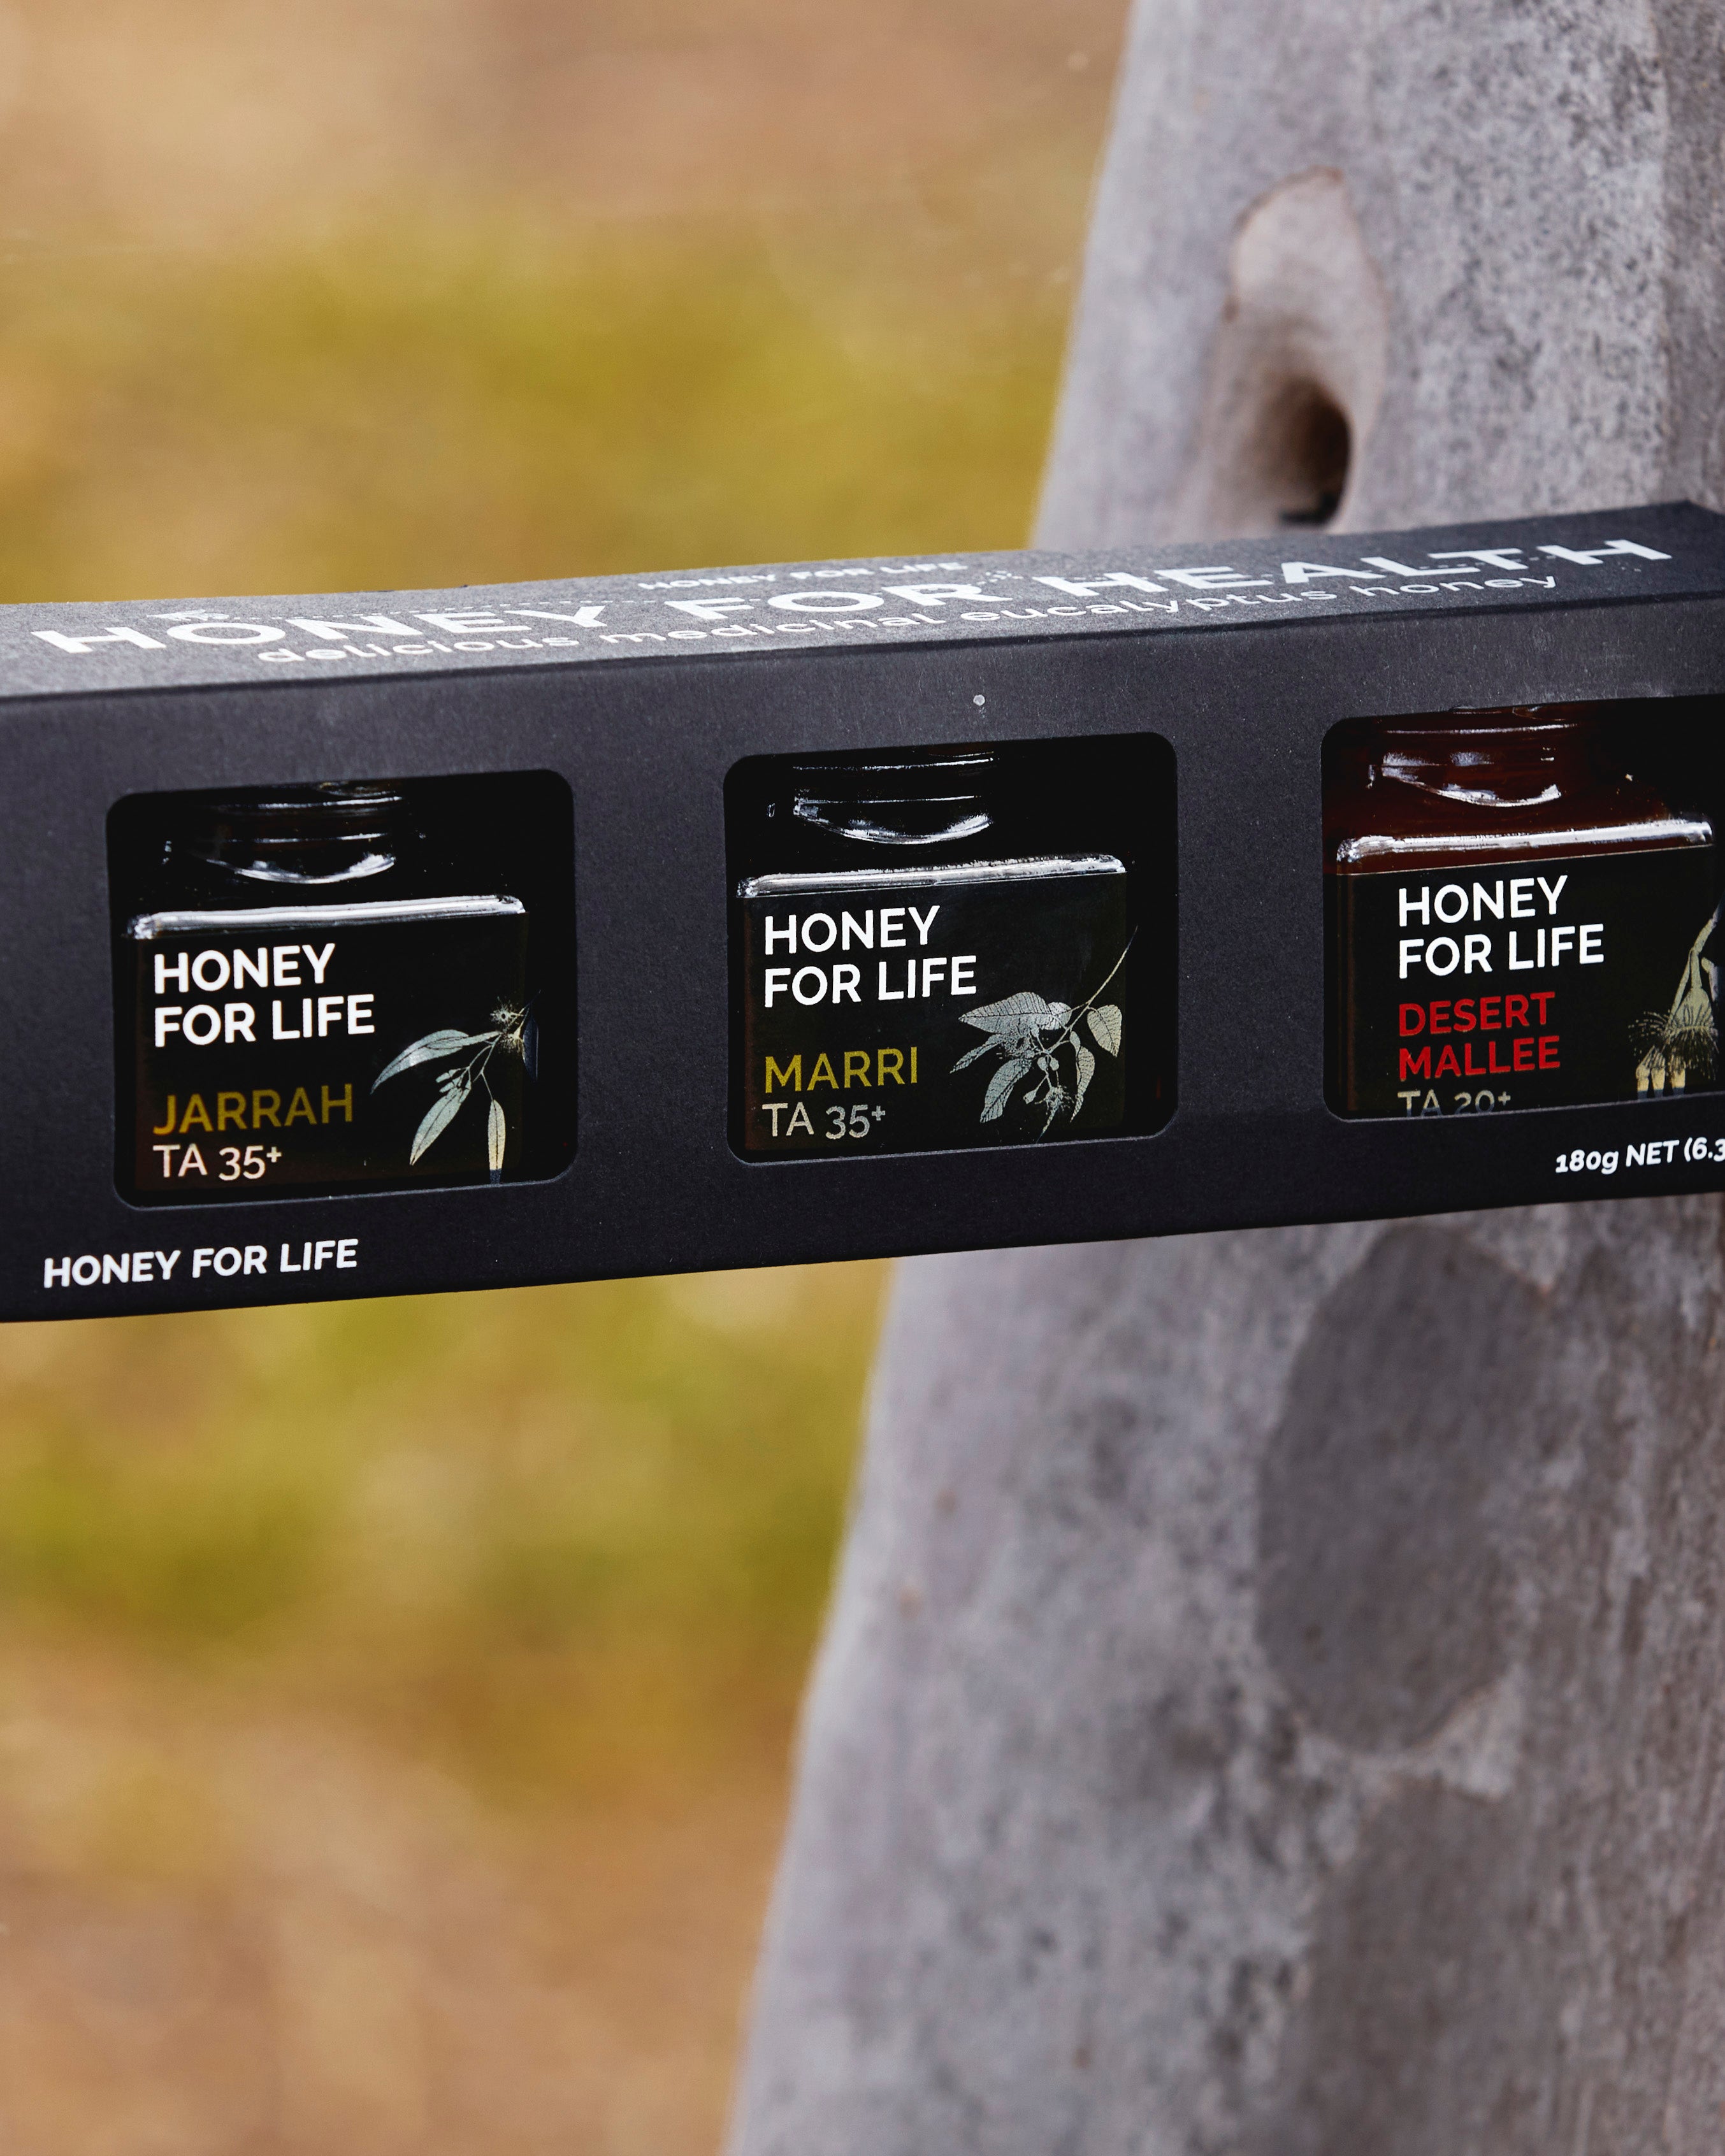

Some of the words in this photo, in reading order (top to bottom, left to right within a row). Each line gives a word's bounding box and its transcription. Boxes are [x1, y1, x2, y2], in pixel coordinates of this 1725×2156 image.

[31, 605, 607, 654] HONEY
[664, 583, 1013, 621] FOR
[1032, 539, 1672, 597] HEALTH
[638, 573, 777, 591] HONEY
[790, 568, 876, 580] FOR
[879, 561, 968, 575] LIFE
[257, 636, 580, 663] delicious
[599, 612, 946, 643] medicinal
[960, 588, 1338, 622] eucalyptus
[1349, 575, 1557, 597] honey
[1399, 875, 1568, 927] HONEY
[765, 905, 940, 955] HONEY
[1399, 935, 1492, 979] FOR
[1508, 924, 1605, 972] LIFE
[154, 943, 336, 995] HONEY
[765, 963, 861, 1008] FOR
[878, 956, 977, 1000] LIFE
[154, 1003, 256, 1048] FOR
[272, 994, 375, 1040] LIFE
[1399, 991, 1556, 1037] DESERT
[765, 1046, 918, 1093] MARRI
[1399, 1035, 1561, 1082] MALLEE
[153, 1084, 354, 1136] JARRAH
[761, 1102, 814, 1137] TA
[825, 1104, 886, 1140] 35+
[1397, 1089, 1443, 1118] TA
[1454, 1089, 1512, 1116] 20+
[153, 1143, 208, 1179] TA
[219, 1146, 282, 1181] 35+
[1555, 1149, 1619, 1175] 180g
[1626, 1139, 1680, 1167] NET
[44, 1249, 182, 1289] HONEY
[192, 1245, 267, 1279] FOR
[280, 1239, 359, 1272] LIFE
